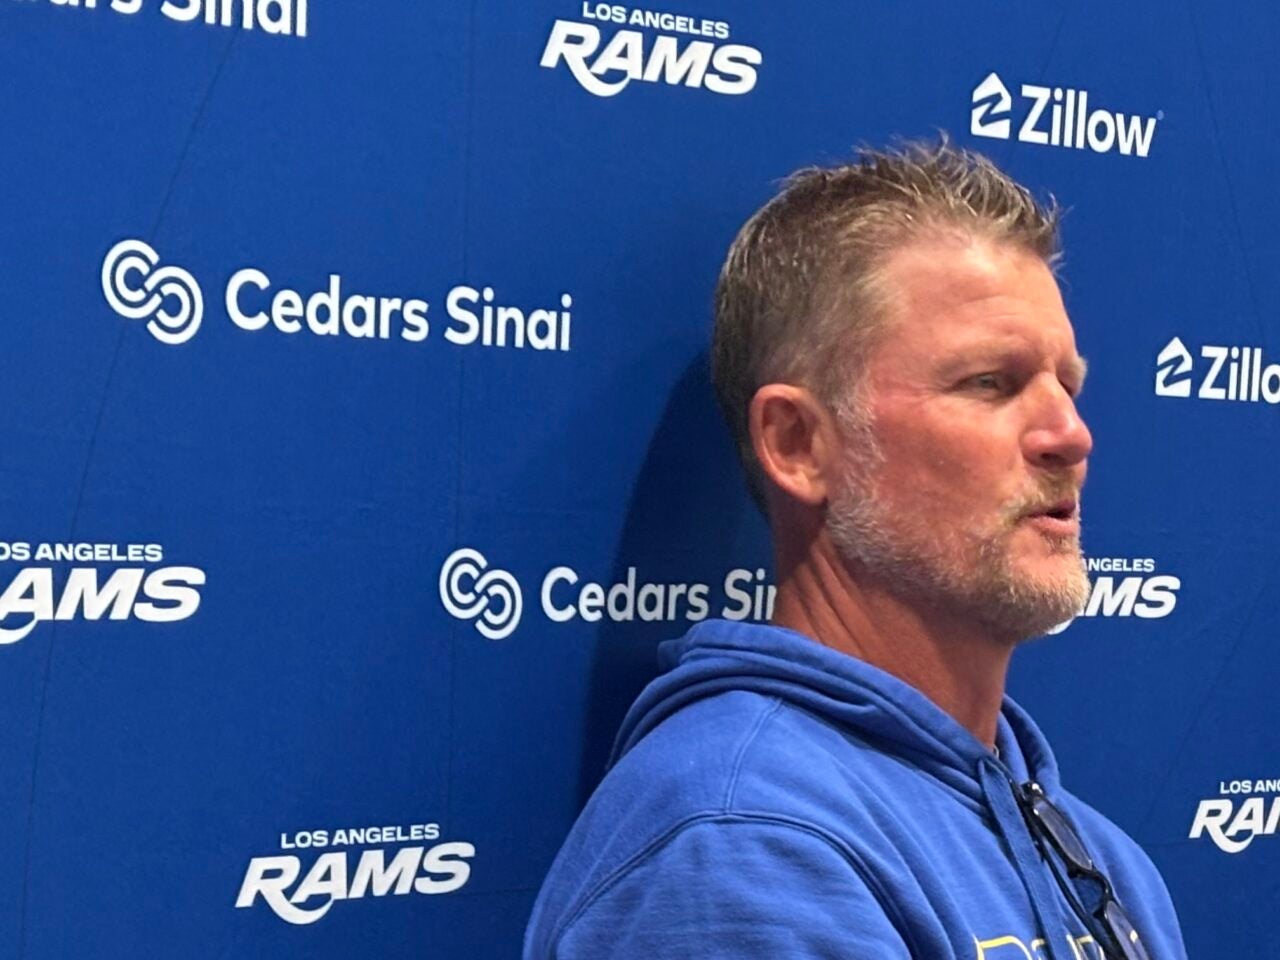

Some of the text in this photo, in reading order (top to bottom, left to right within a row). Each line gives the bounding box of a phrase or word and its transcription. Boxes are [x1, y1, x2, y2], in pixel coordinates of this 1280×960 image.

[584, 1, 729, 39] LOS ANGELES
[540, 19, 763, 97] RAMS
[1018, 84, 1157, 157] Zillow
[225, 268, 572, 351] Cedars Sinai
[0, 542, 163, 562] OS ANGELES
[0, 566, 206, 645] AMS
[541, 566, 709, 622] Cedars
[1050, 575, 1181, 635] MS
[1220, 780, 1252, 794] LOS
[281, 823, 440, 849] LOS ANGELES
[235, 841, 476, 925] RAMS
